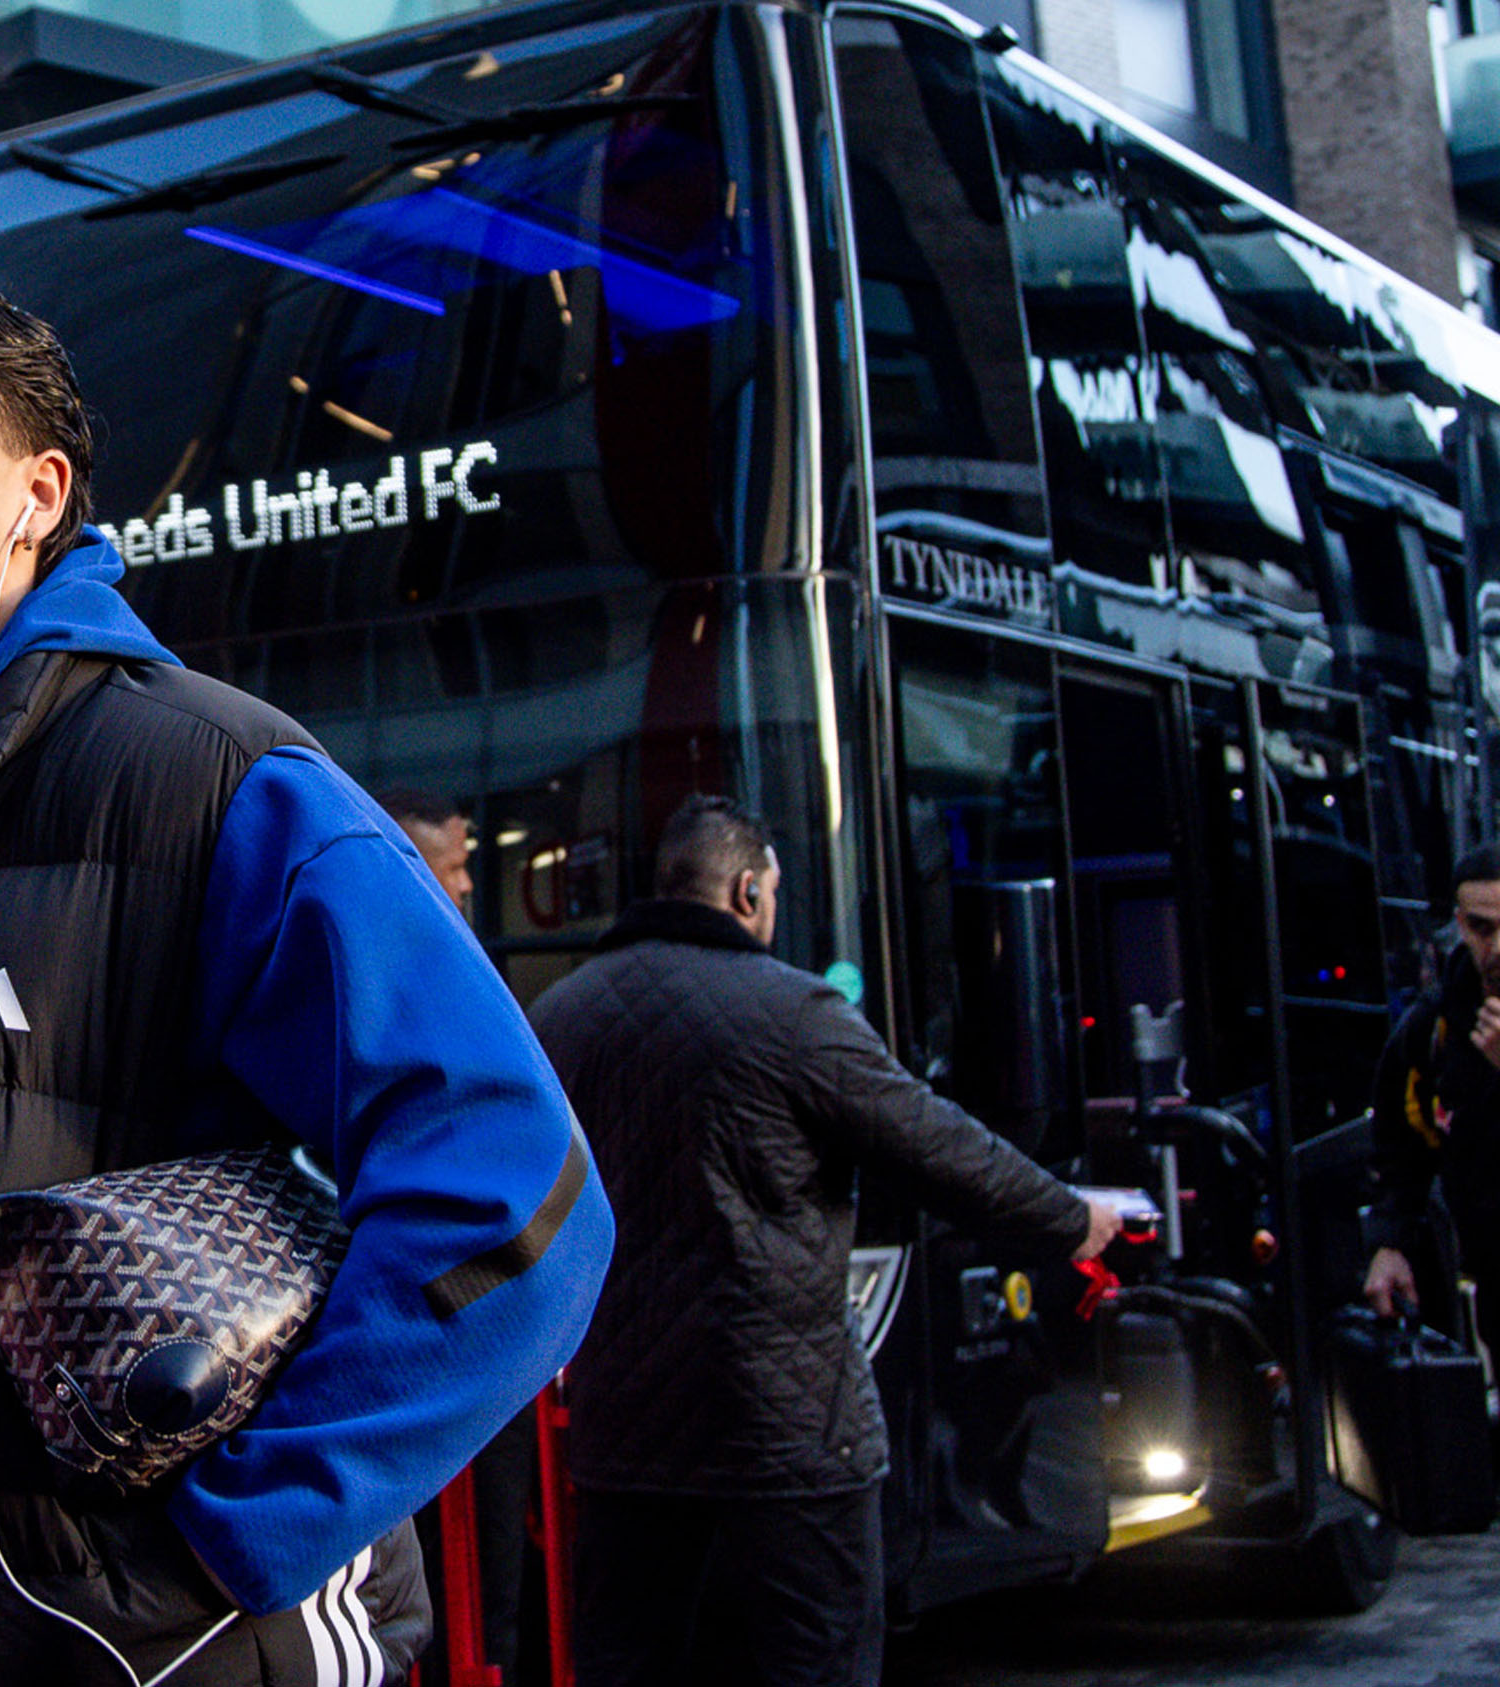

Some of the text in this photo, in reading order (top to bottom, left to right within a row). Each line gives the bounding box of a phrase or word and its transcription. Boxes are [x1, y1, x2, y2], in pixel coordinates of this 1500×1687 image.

[224, 455, 409, 550] United
[420, 440, 500, 521] FC
[884, 534, 1050, 617] TYNEDALE
